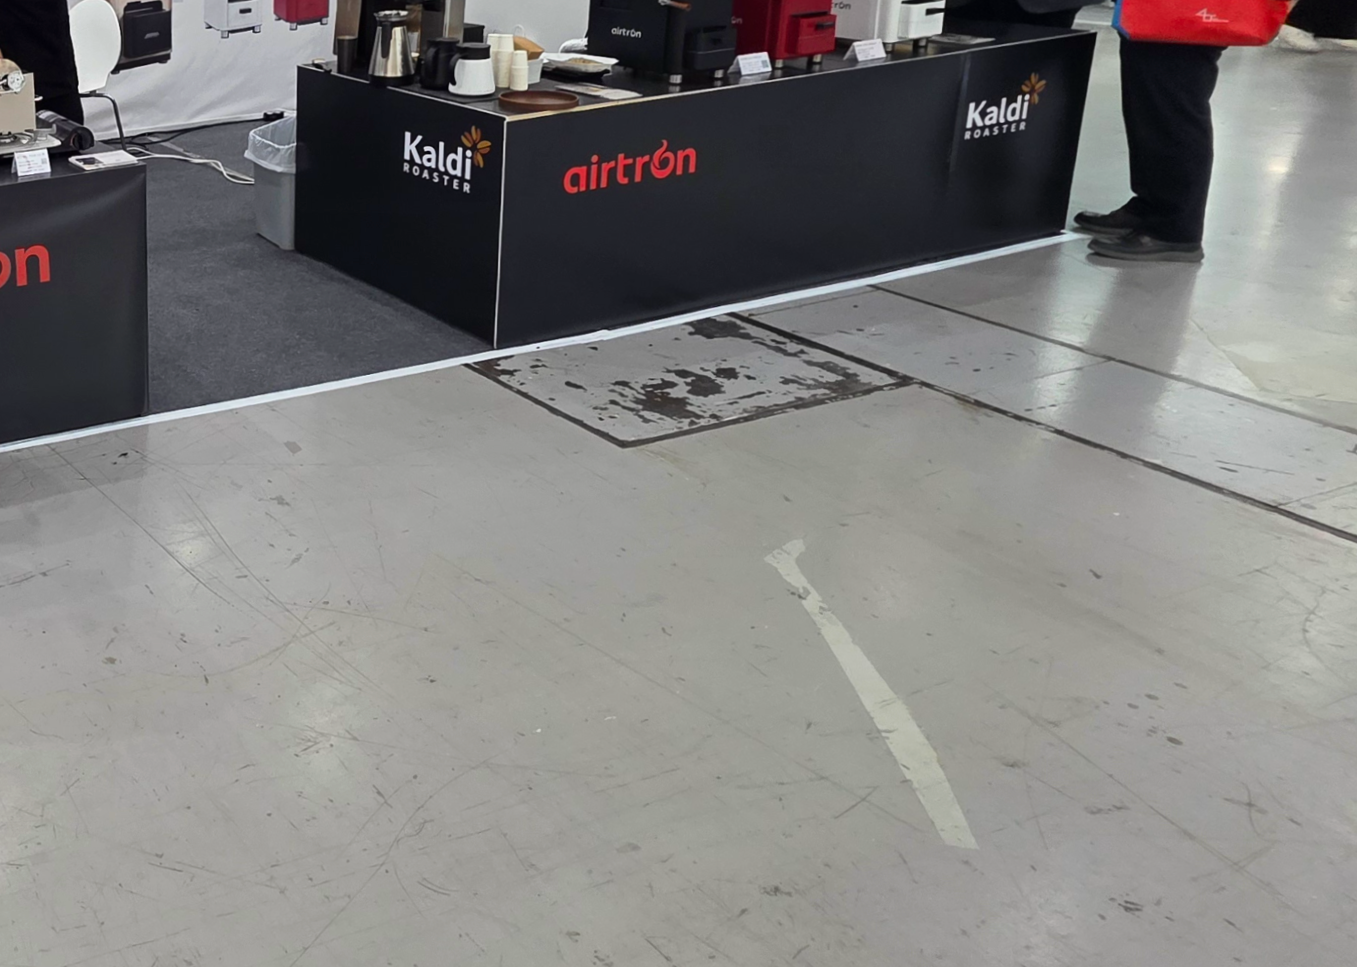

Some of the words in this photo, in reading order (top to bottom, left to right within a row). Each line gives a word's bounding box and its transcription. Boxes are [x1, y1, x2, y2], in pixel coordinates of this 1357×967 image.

[965, 94, 1031, 129] Kaldi
[963, 121, 1027, 140] ROASTER
[403, 130, 473, 181] Kaldi
[403, 162, 471, 194] ROASTER
